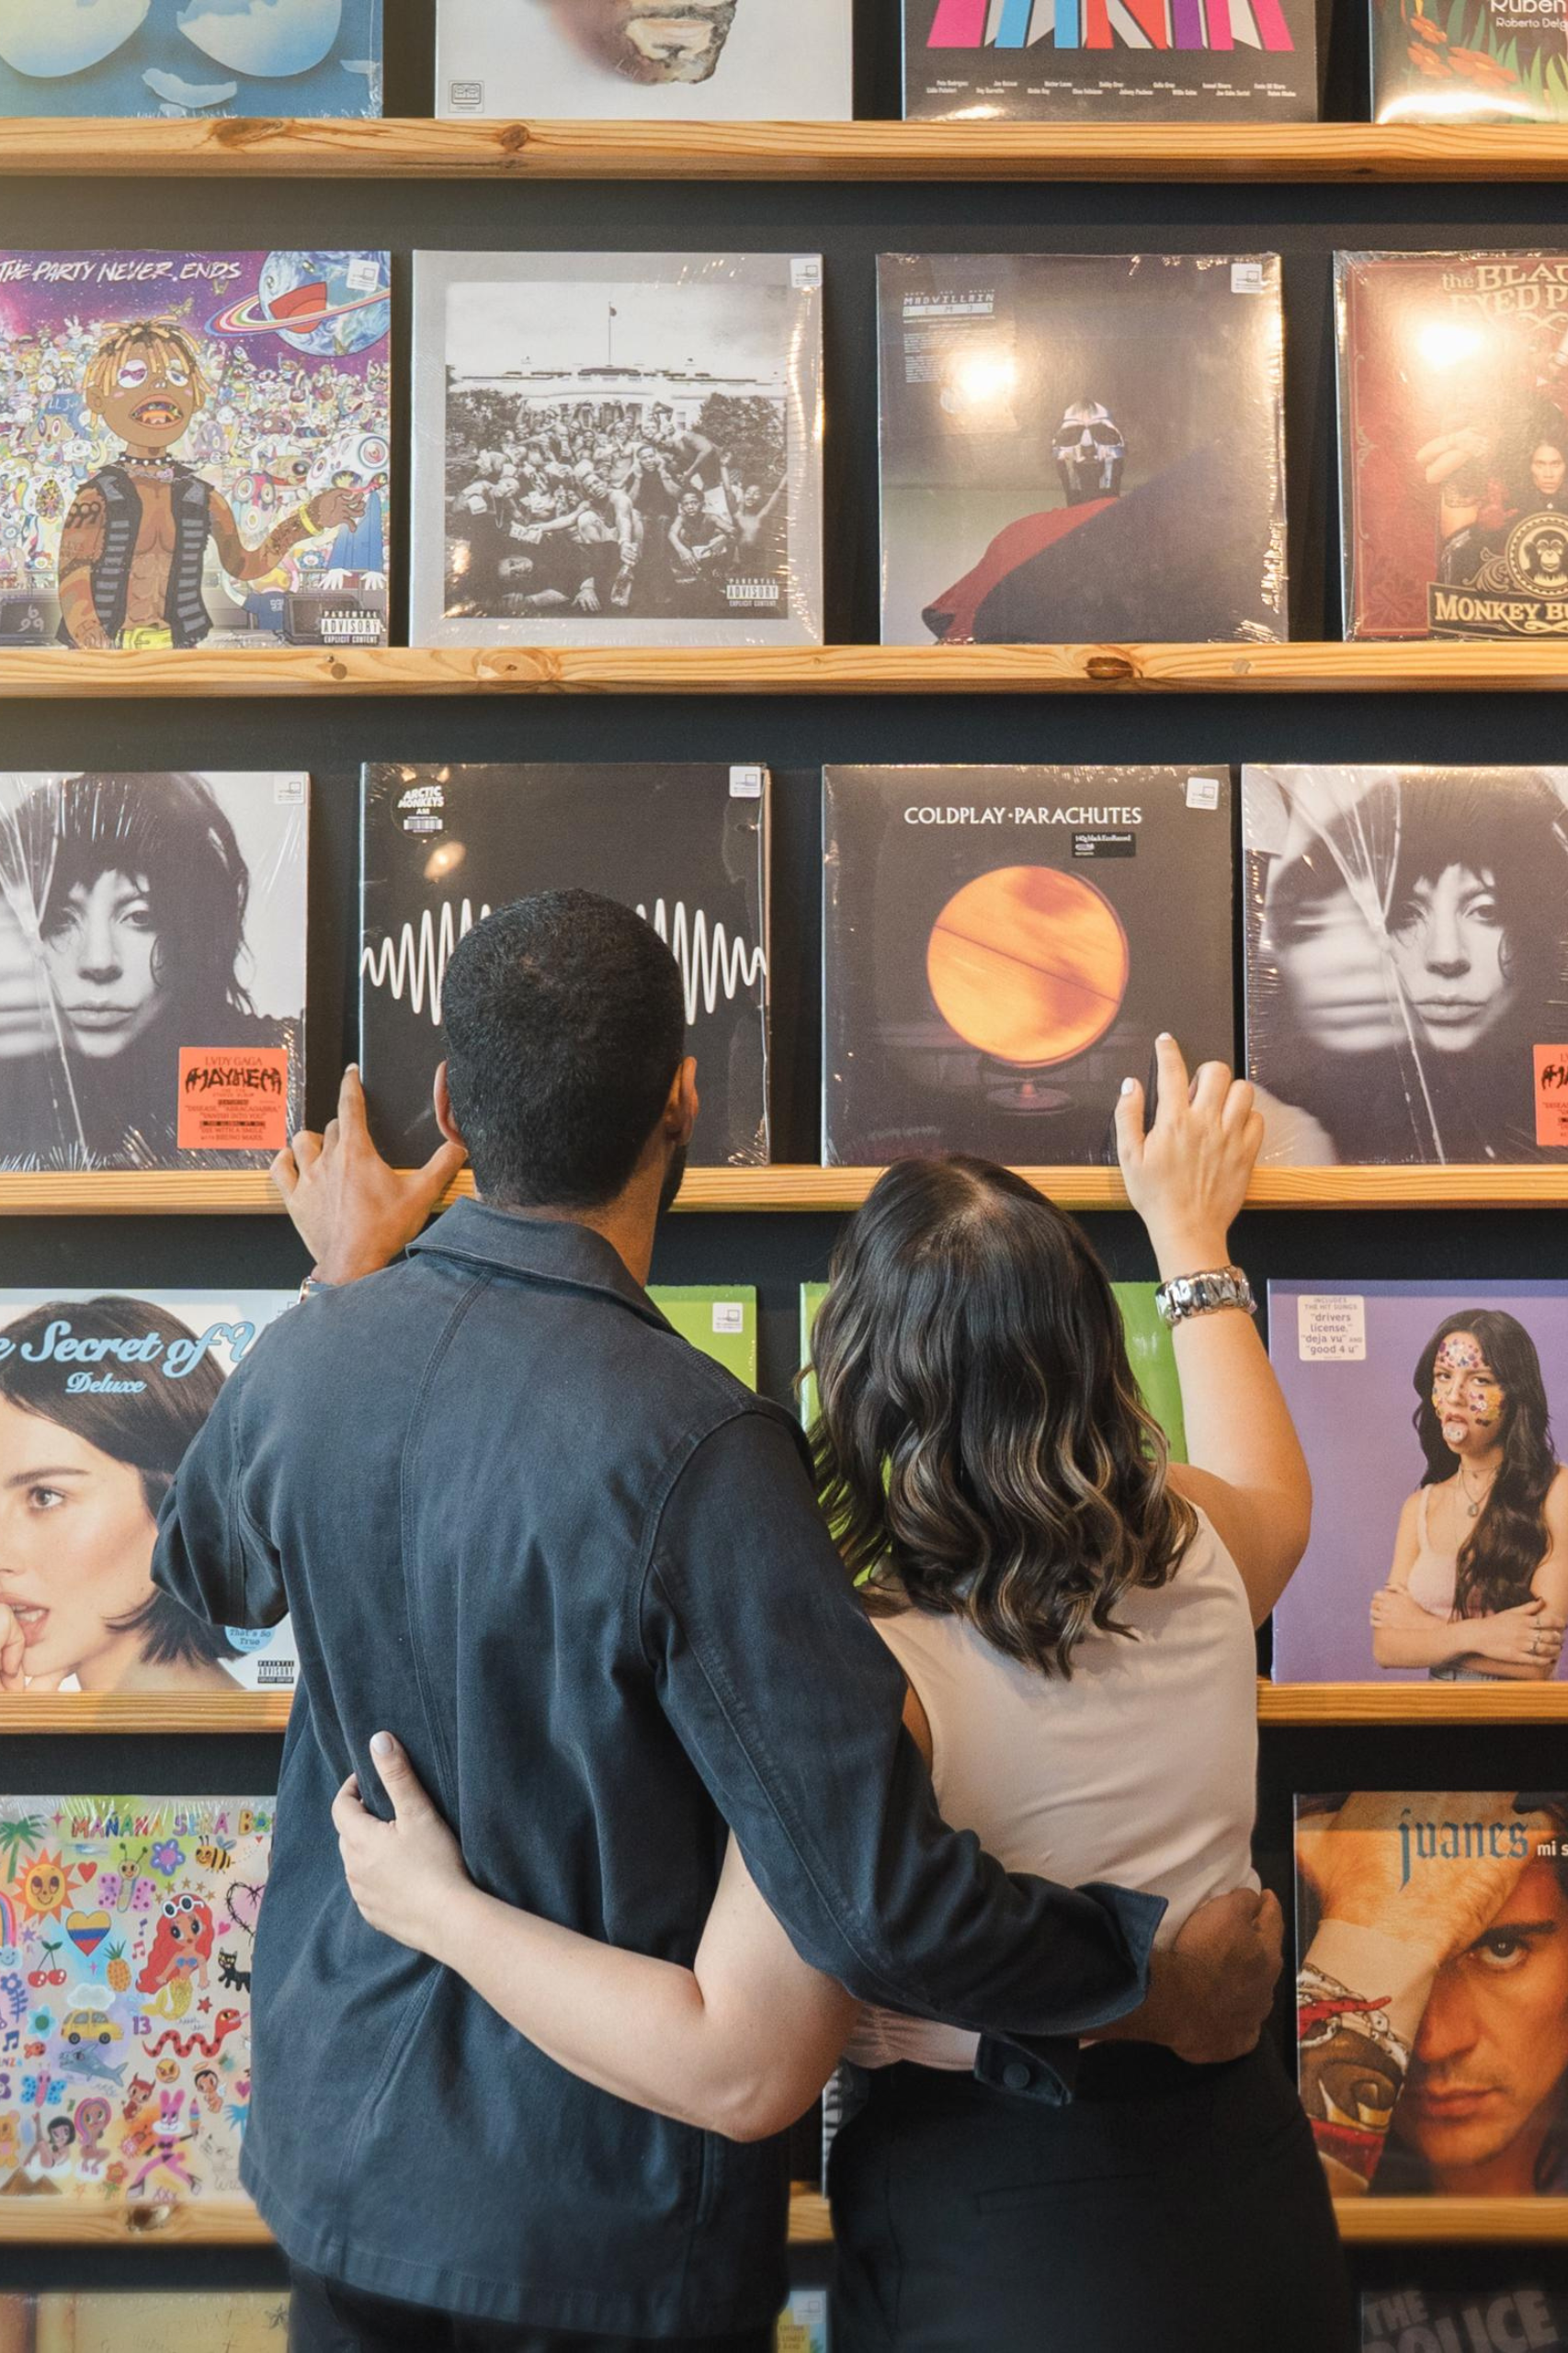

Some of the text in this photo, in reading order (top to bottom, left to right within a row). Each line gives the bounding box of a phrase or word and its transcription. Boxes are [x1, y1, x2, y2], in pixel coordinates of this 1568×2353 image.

[1496, 17, 1540, 28] Roberto
[32, 260, 95, 281] PARTY
[97, 261, 173, 282] NEVER
[180, 262, 243, 279] ENDS
[1441, 273, 1474, 291] the
[903, 294, 994, 305] MADVILLAIN
[729, 586, 777, 597] ADVISORY
[324, 610, 378, 619] PARENTAL
[1435, 592, 1541, 626] MONKEY
[324, 620, 378, 632] ADVISORY
[324, 635, 378, 643] EXPLICIT CONTENT
[403, 786, 442, 799] ARCTIC
[397, 797, 444, 808] MONKEYS
[904, 807, 1142, 824] COLDPLAY PARACHUTES
[233, 1057, 263, 1067] GAGA
[20, 1320, 164, 1363] Secret
[162, 1323, 230, 1379] of
[1338, 1345, 1345, 1353] 4
[65, 1370, 147, 1394] Deluxe
[260, 1630, 271, 1638] So
[239, 1637, 261, 1645] True
[259, 1667, 293, 1676] ADVISORY
[71, 1811, 165, 1837] MAÑANA
[173, 1811, 230, 1837] SERÁ
[1398, 1808, 1529, 1893] juanes
[1537, 1840, 1556, 1856] mi
[132, 2016, 152, 2035] 13
[1362, 2290, 1428, 2336] THE
